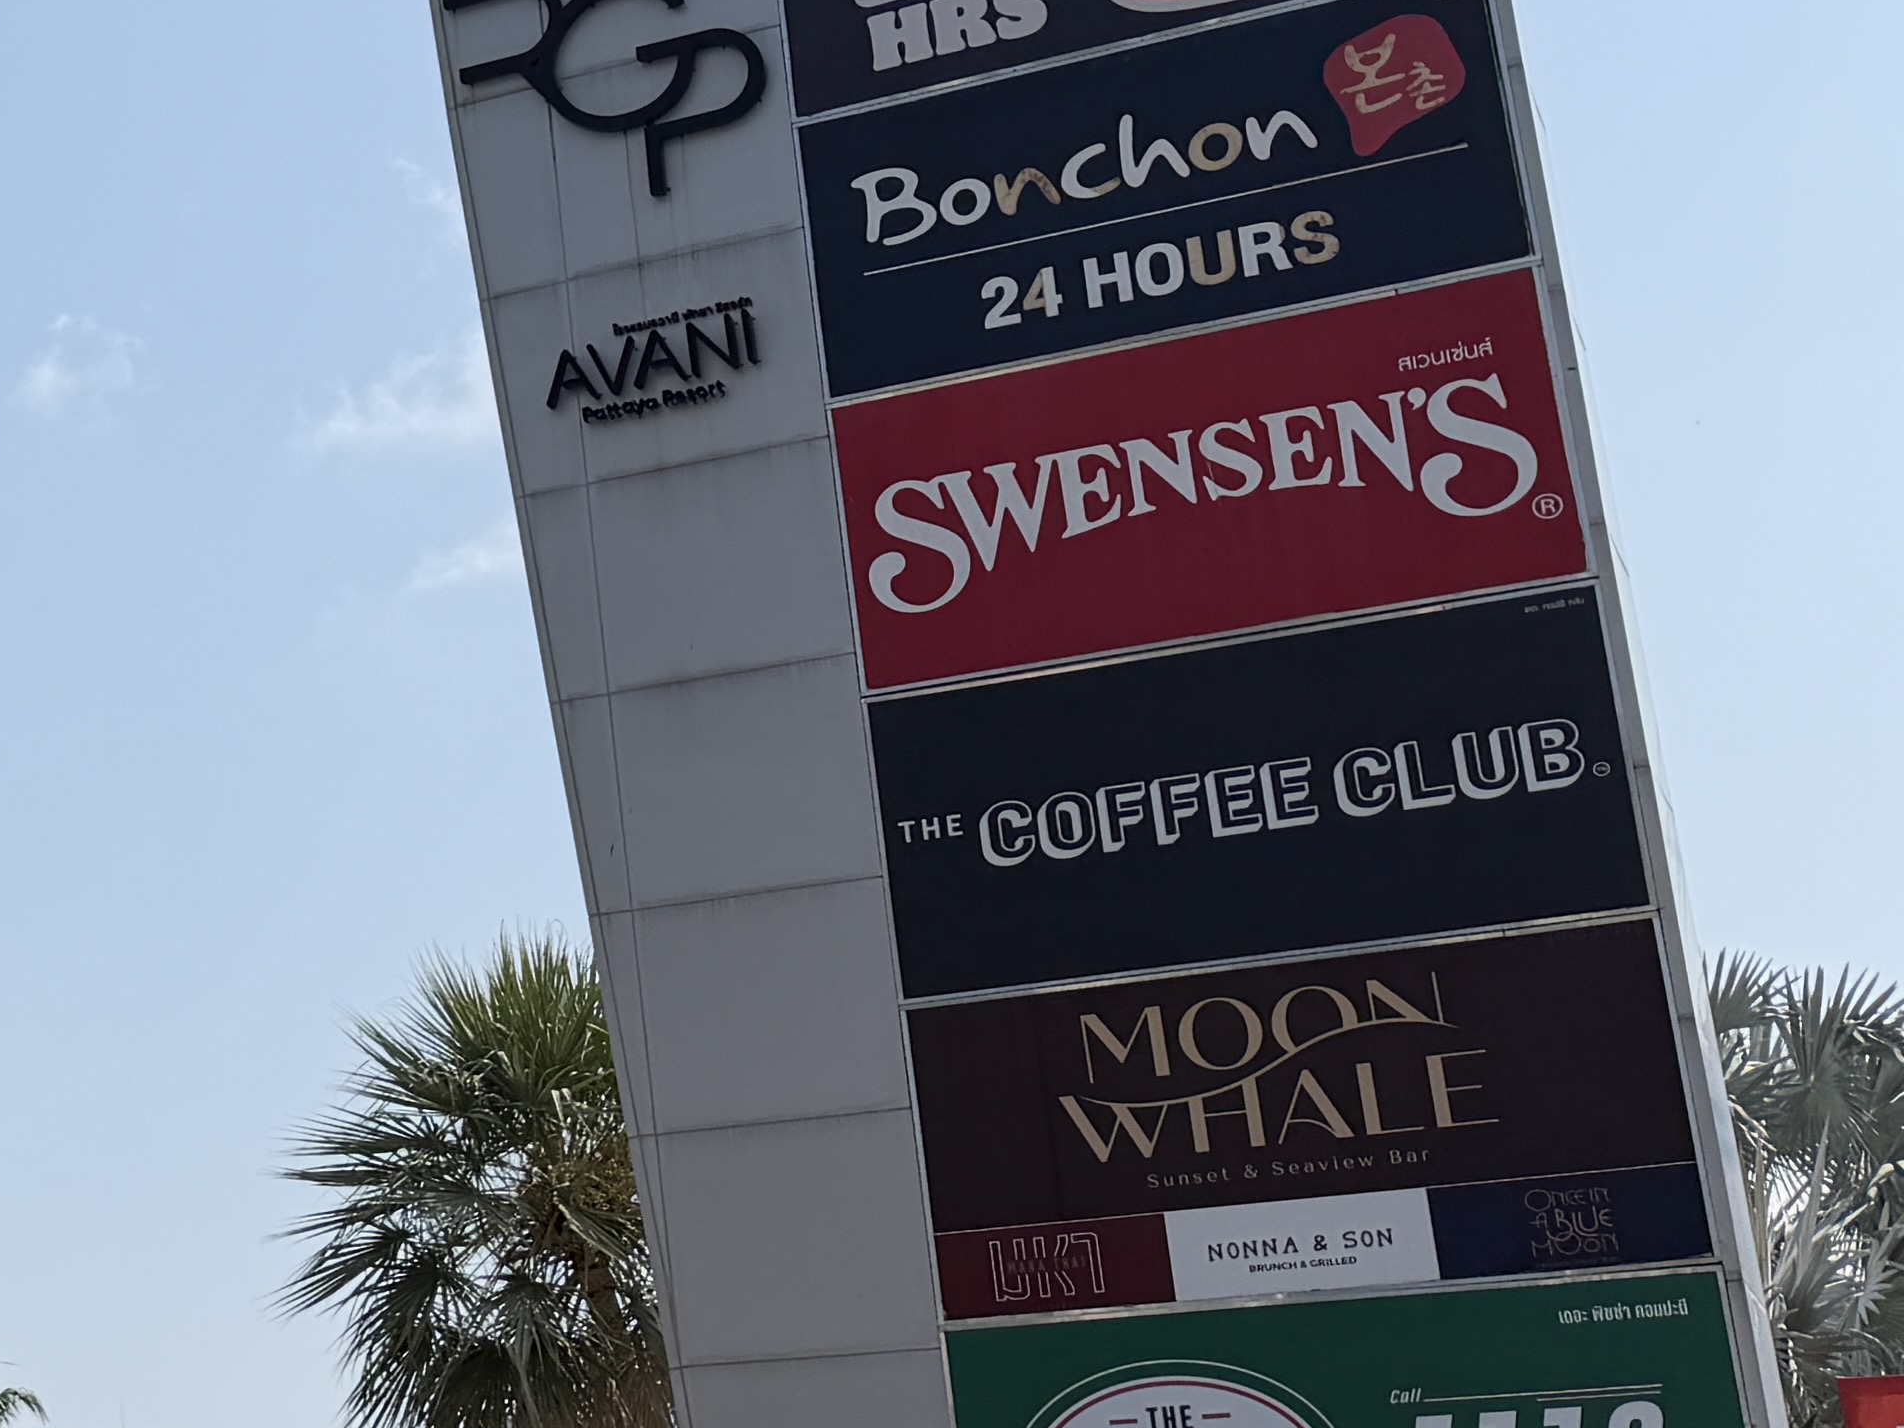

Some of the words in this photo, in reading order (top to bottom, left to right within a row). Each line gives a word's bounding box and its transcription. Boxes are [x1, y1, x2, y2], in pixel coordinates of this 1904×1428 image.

[851, 108, 1318, 247] Bonchon
[980, 266, 1063, 330] 24
[1081, 210, 1341, 310] HOURS
[546, 308, 761, 410] AVANI
[582, 396, 660, 423] Pattaya
[662, 379, 726, 408] Resort
[1398, 337, 1493, 372] สเวนเซ่นส์
[868, 372, 1539, 614] SWENSEN'S
[897, 813, 965, 845] THE
[979, 756, 1320, 867] COFFEE
[1334, 718, 1585, 817] CLUB
[1079, 971, 1446, 1085] MOON
[1058, 1048, 1500, 1163] WHALE
[1147, 1167, 1231, 1188] Sunset
[1244, 1164, 1258, 1179] &
[1272, 1154, 1374, 1177] Seaview
[1389, 1149, 1430, 1164] Bar
[1208, 1236, 1299, 1262] NONNA
[1314, 1235, 1328, 1251] &
[1342, 1228, 1393, 1249] SON
[1249, 1260, 1297, 1273] BRUNCH
[1310, 1256, 1357, 1268] GRILLED
[1390, 1388, 1421, 1404] Call
